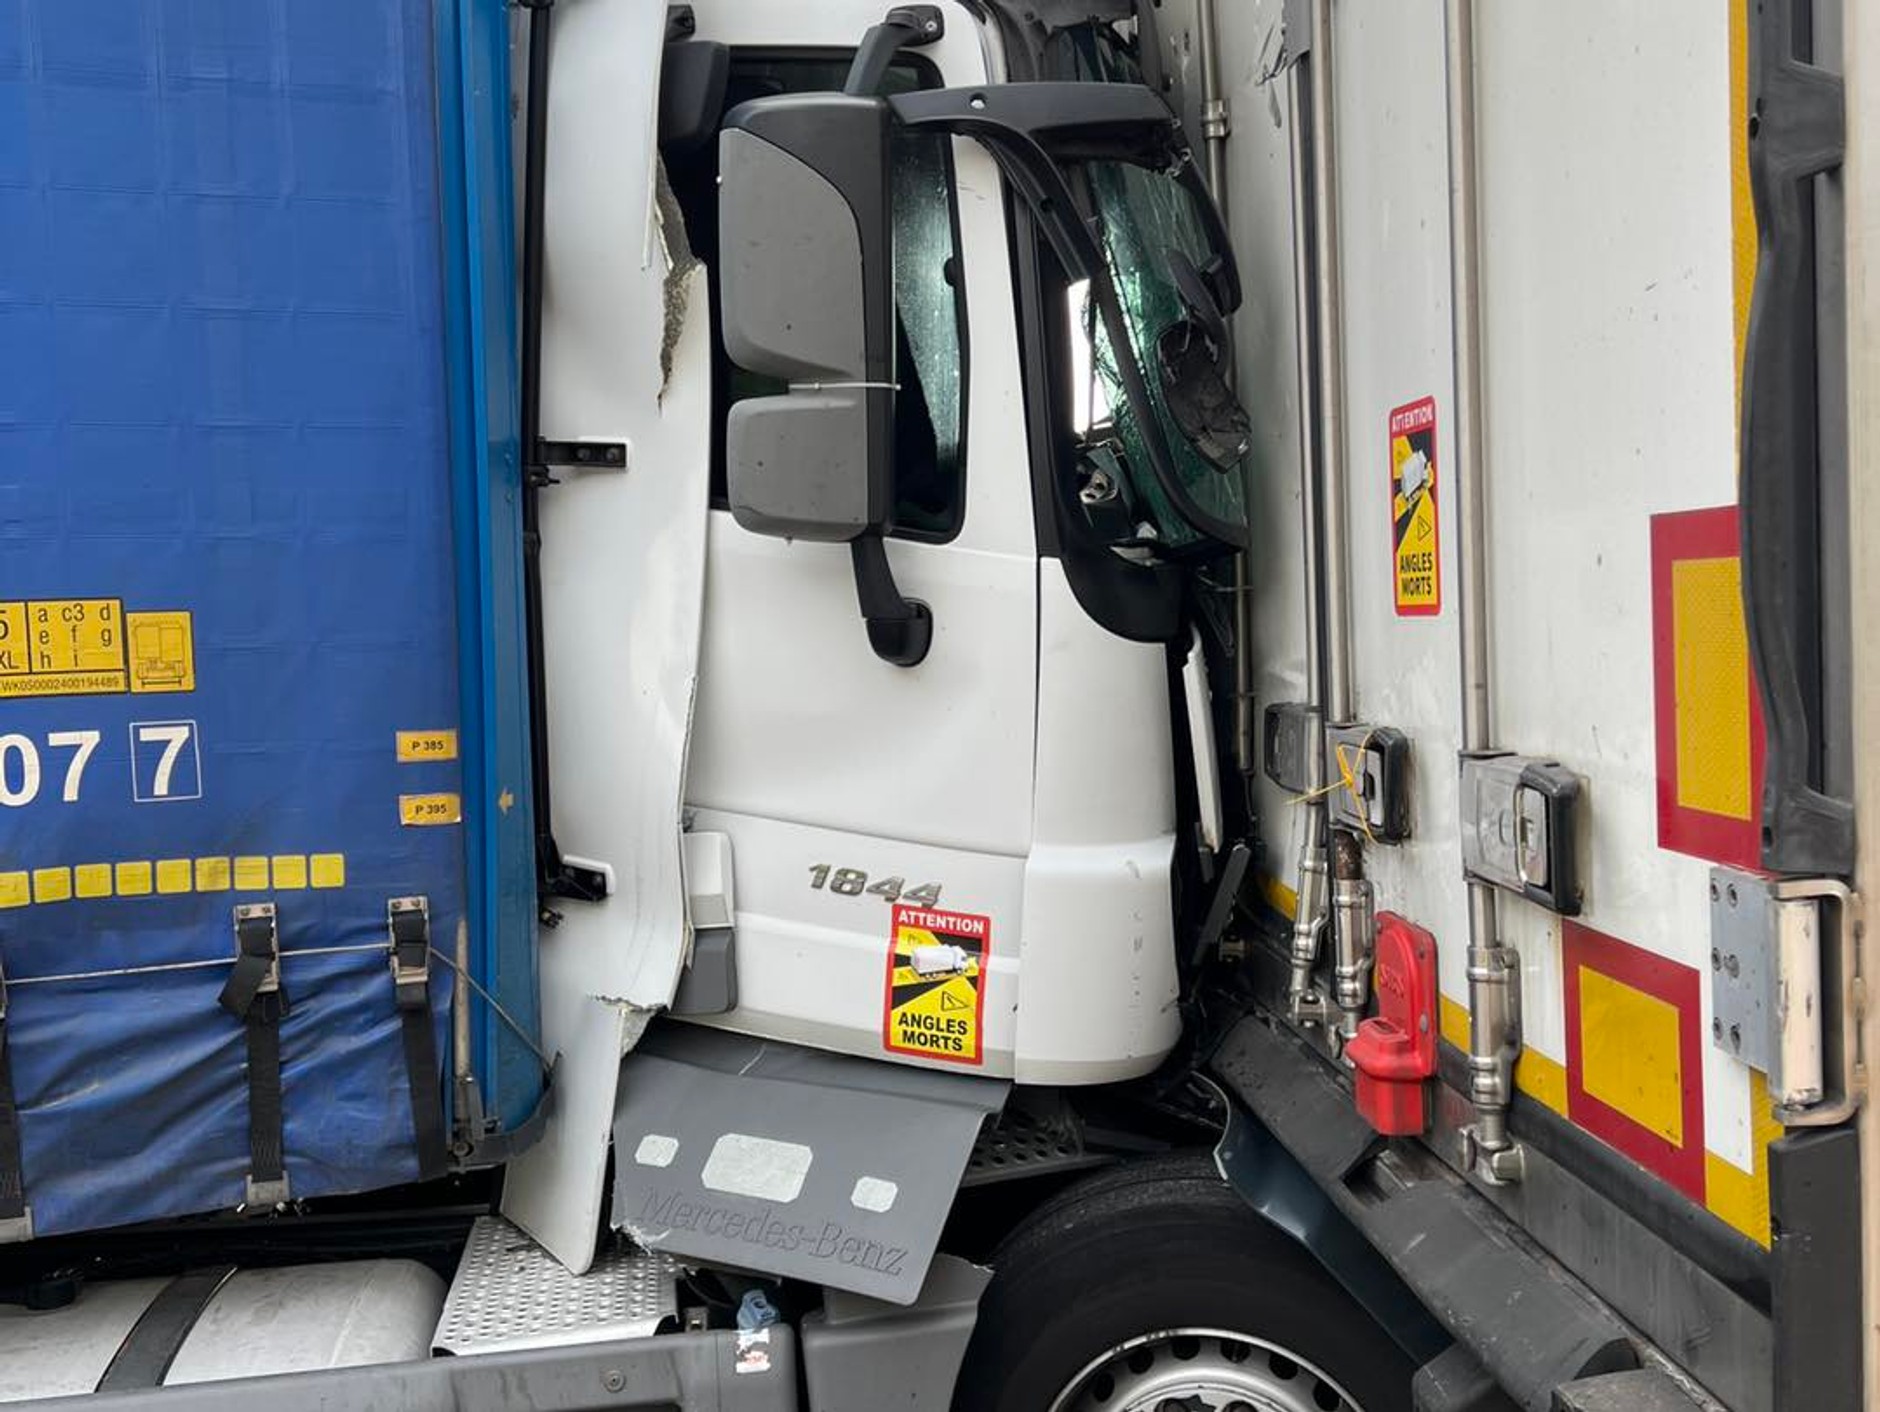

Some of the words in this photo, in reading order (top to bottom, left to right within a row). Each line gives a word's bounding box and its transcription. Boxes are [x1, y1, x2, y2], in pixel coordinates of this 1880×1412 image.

[1392, 403, 1434, 433] ATTENTION
[1400, 553, 1433, 573] ANGLES
[1401, 576, 1433, 596] MORTS
[38, 607, 49, 623] a
[62, 603, 85, 623] c3
[100, 603, 111, 622] d
[39, 630, 50, 645] e
[71, 625, 78, 644] f
[101, 628, 112, 648] g
[40, 651, 52, 669] h
[412, 741, 420, 752] P
[423, 740, 444, 751] 385
[139, 726, 190, 796] 7
[415, 804, 424, 815] P
[426, 804, 447, 814] 395
[809, 863, 942, 908] 1844
[898, 910, 984, 934] ATTENTION
[898, 1011, 968, 1035] ANGLES
[902, 1030, 963, 1052] MORTS
[638, 1186, 910, 1277] Mercedes-Benz
